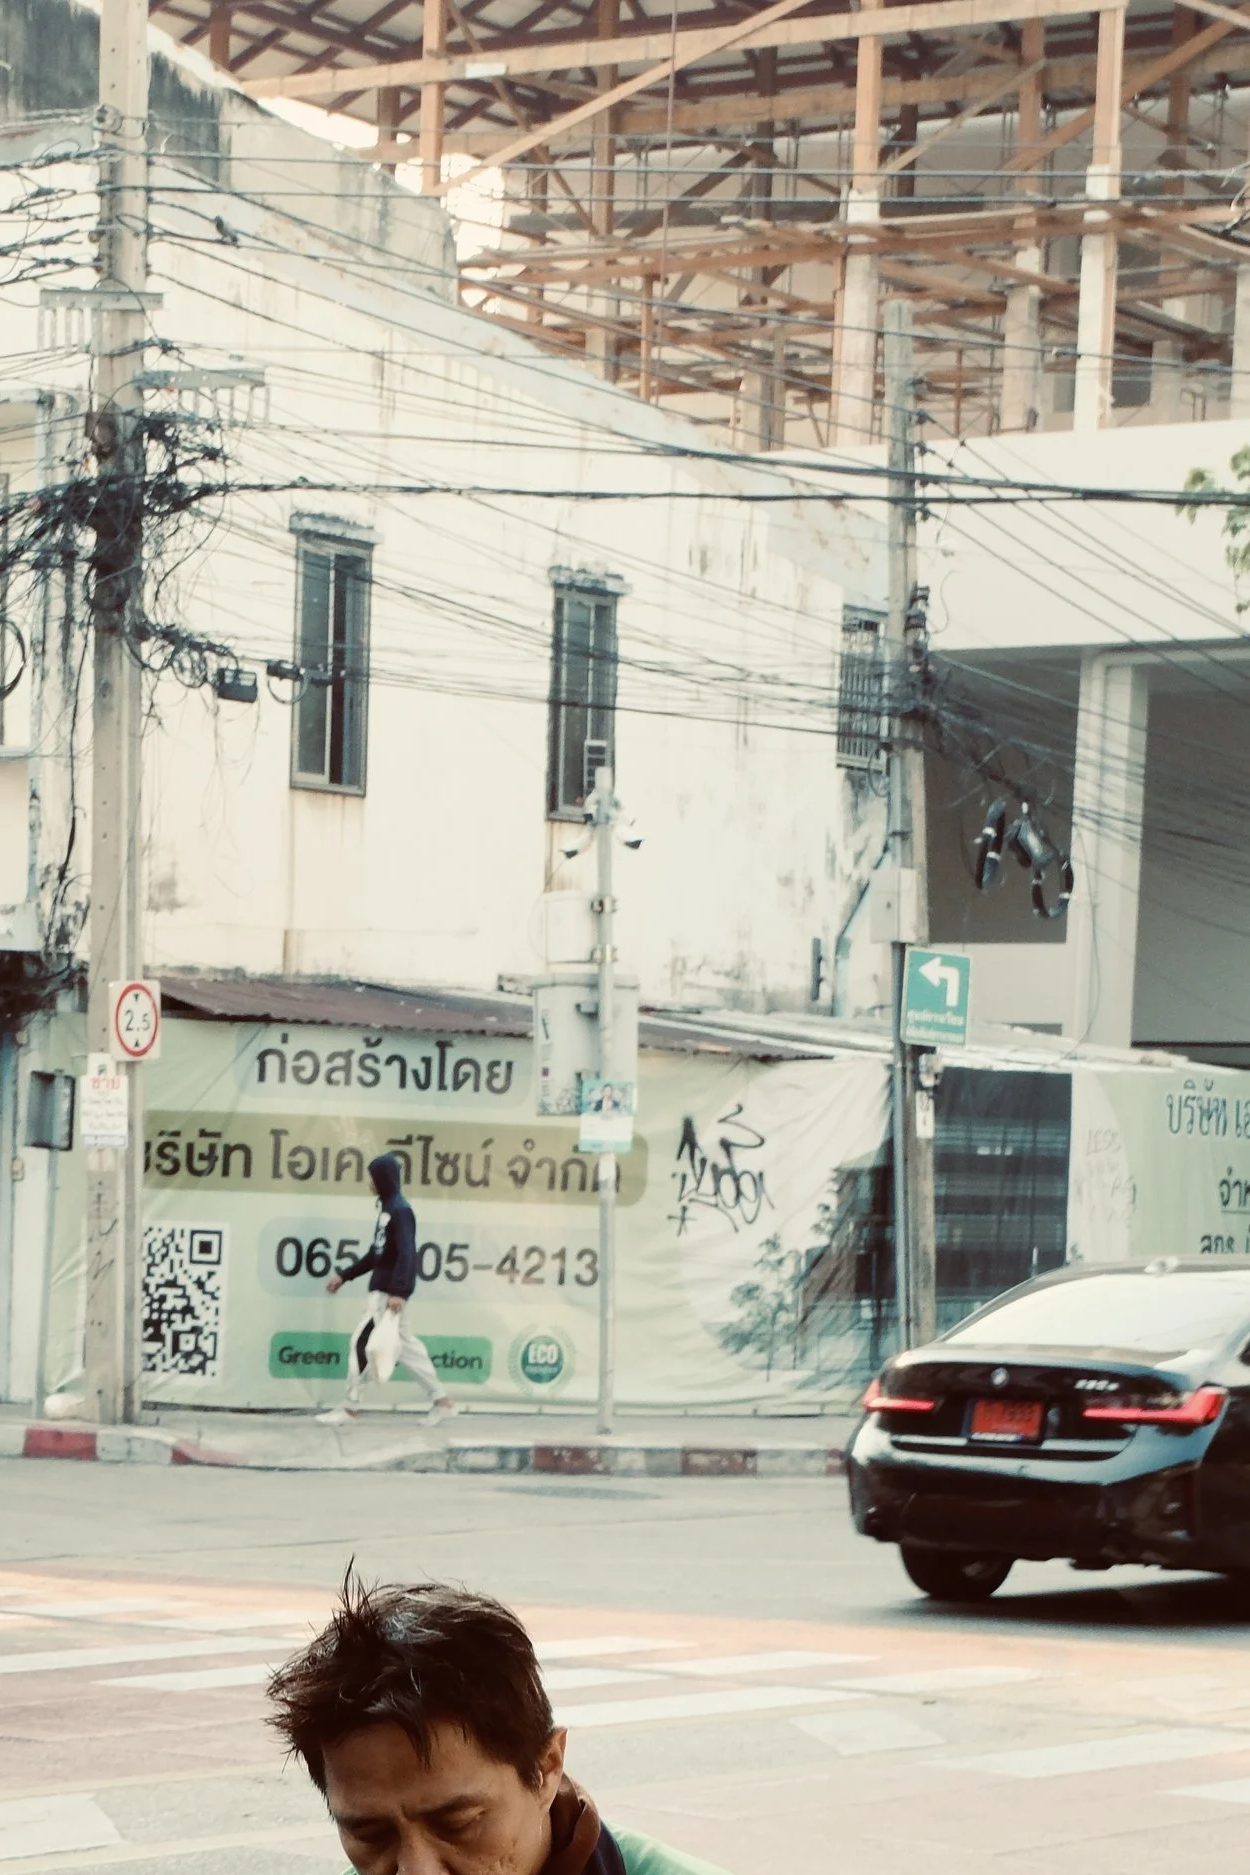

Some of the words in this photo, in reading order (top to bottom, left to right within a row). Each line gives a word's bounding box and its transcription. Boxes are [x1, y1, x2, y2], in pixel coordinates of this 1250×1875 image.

[124, 1009, 150, 1032] 2.5
[257, 1032, 514, 1095] ก่อสร้างโดย
[270, 1128, 364, 1182] โอเค
[507, 1138, 621, 1192] จำก
[278, 1345, 341, 1367] Green
